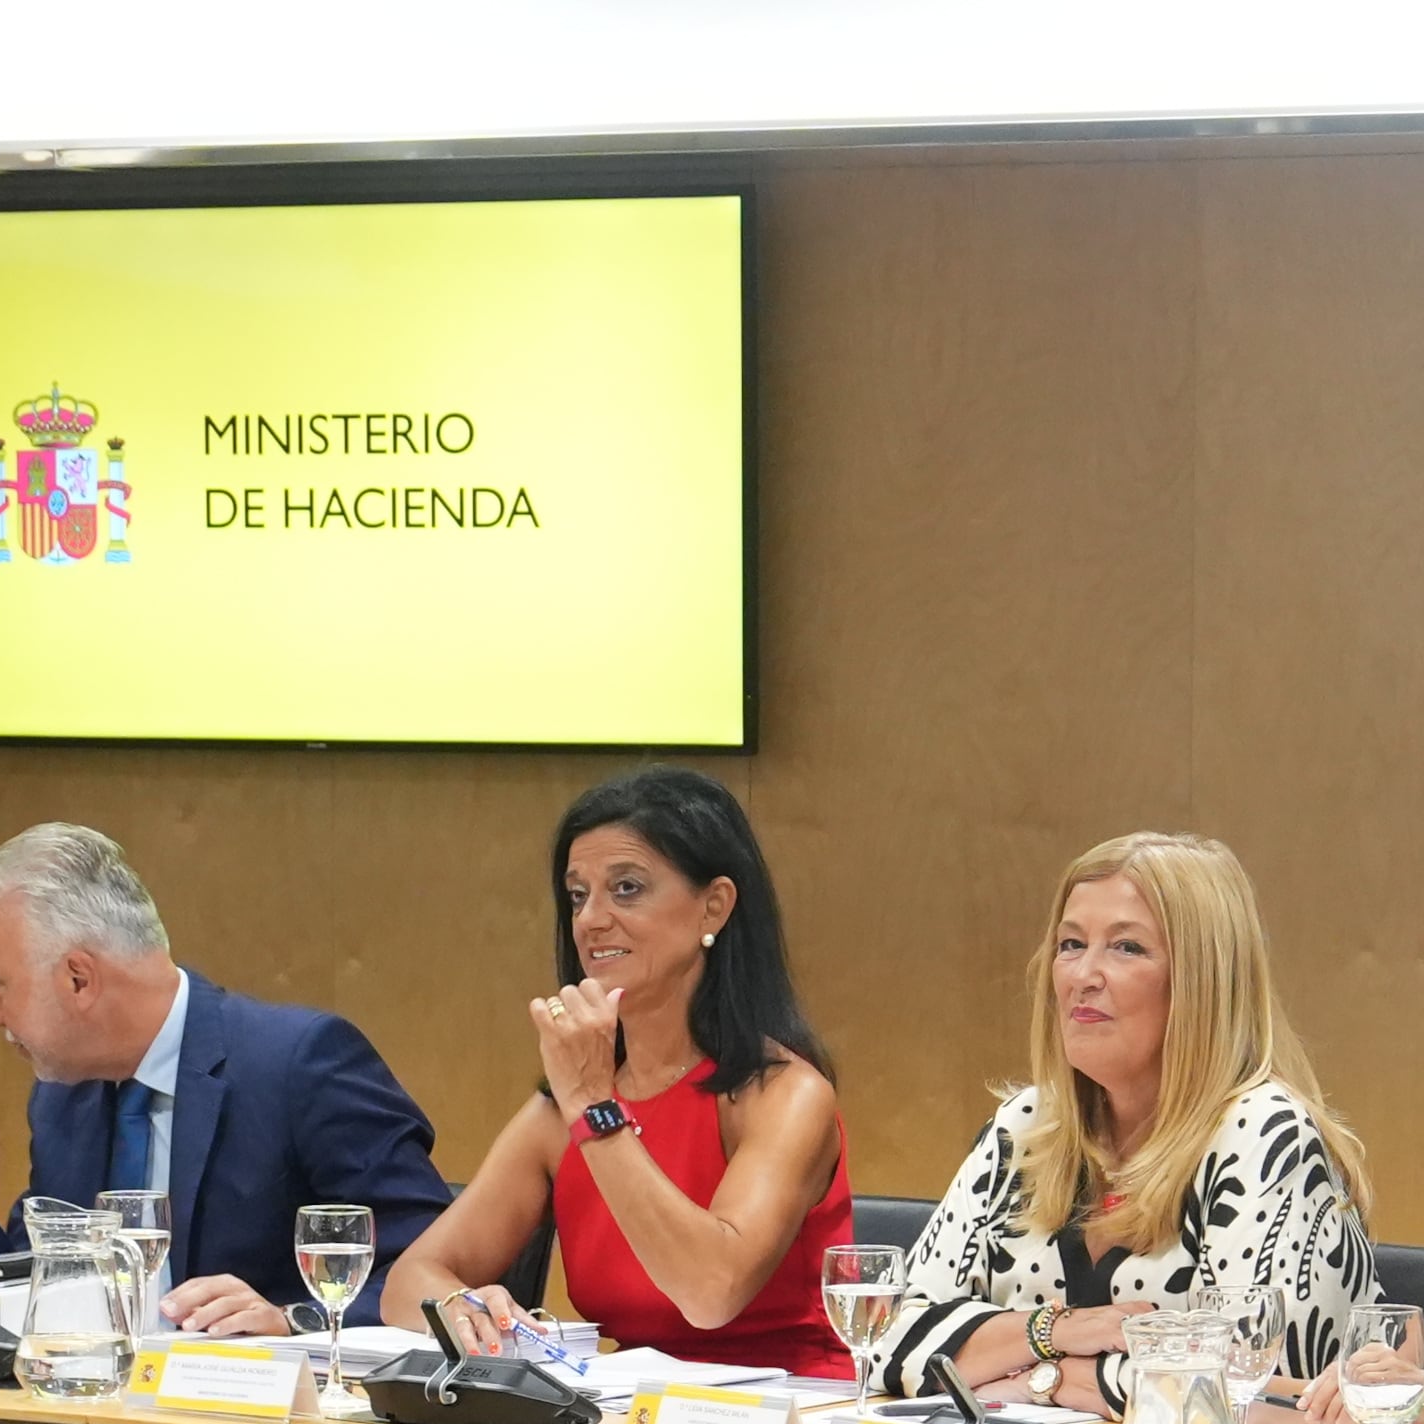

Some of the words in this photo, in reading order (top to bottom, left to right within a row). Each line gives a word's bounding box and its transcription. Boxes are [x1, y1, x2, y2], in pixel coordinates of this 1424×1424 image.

[204, 413, 474, 455] MINISTERIO
[206, 488, 265, 528] DE
[284, 488, 539, 528] HACIENDA
